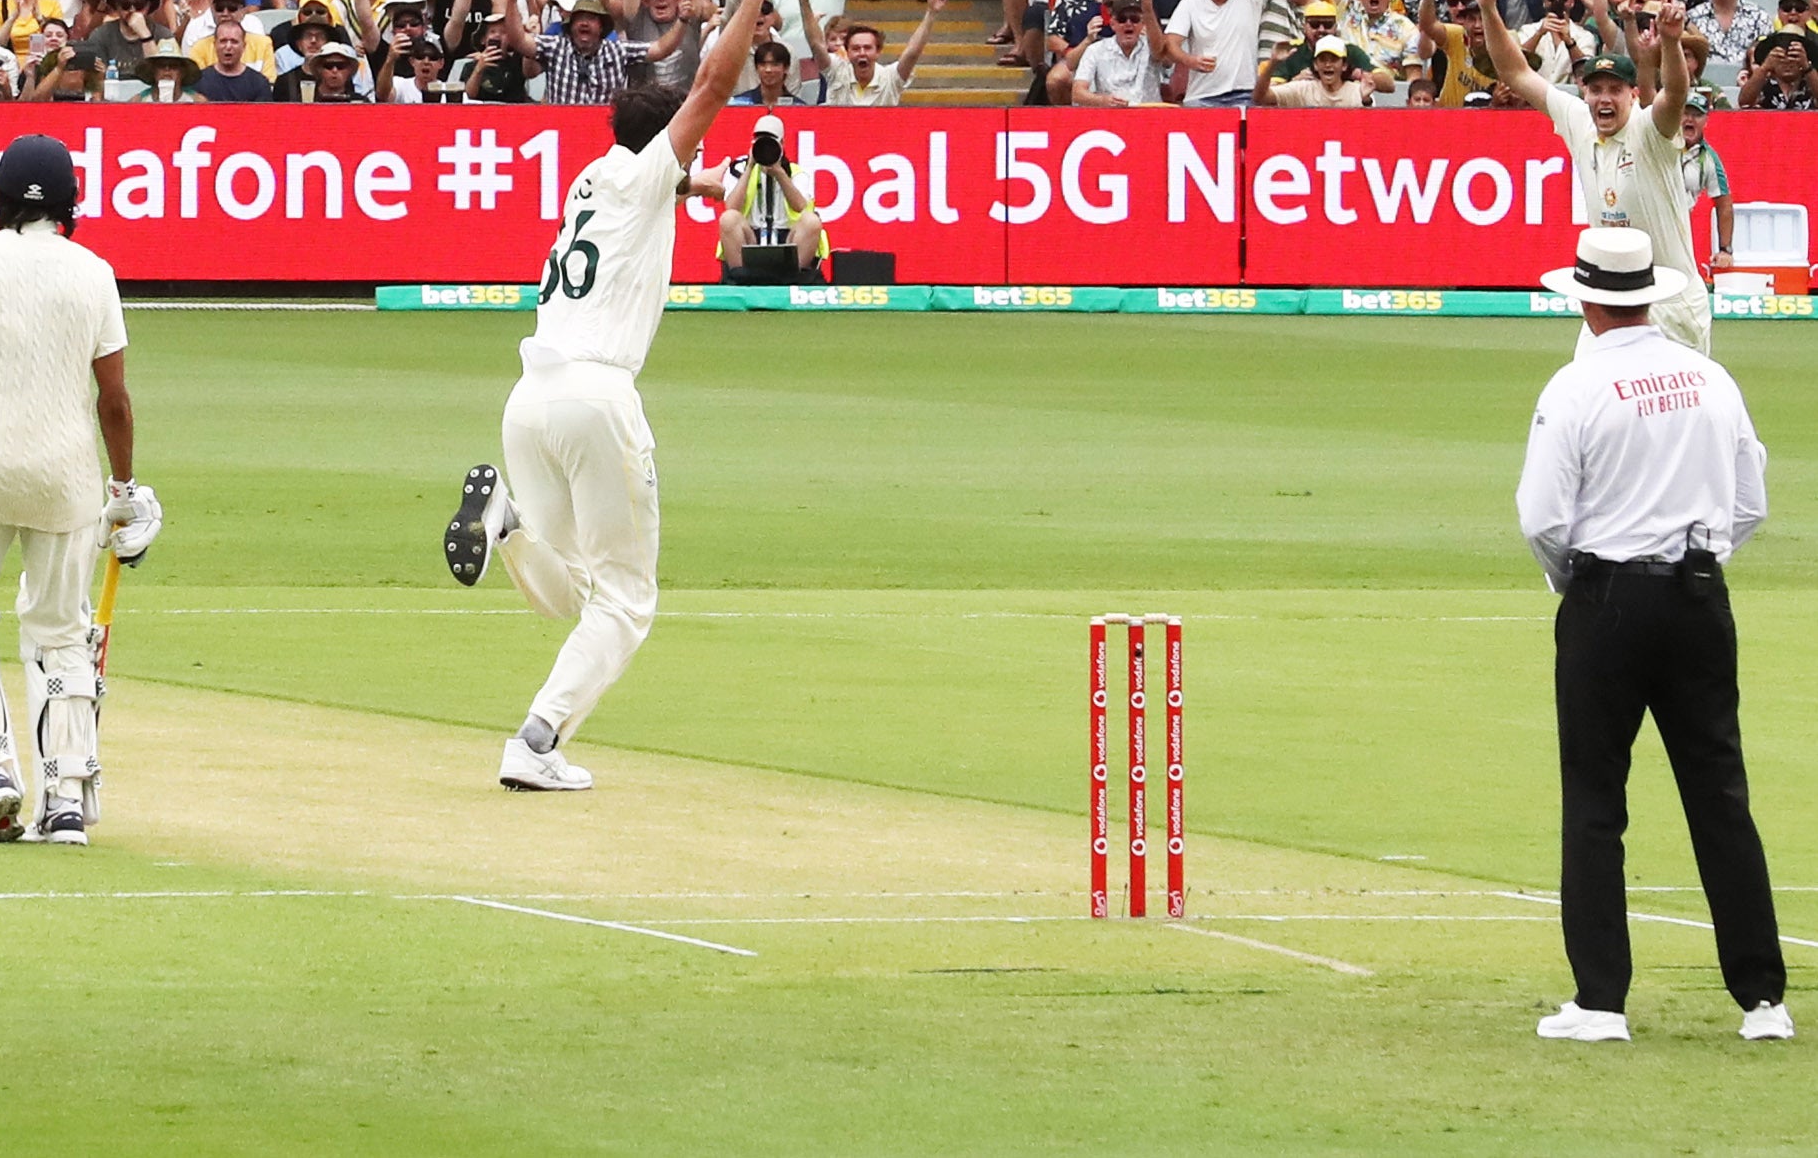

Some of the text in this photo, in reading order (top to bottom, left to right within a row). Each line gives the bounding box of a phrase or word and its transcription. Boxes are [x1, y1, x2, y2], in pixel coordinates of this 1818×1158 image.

[438, 129, 560, 220] #1
[988, 129, 1129, 225] 5G
[421, 285, 520, 305] bet365
[789, 285, 889, 305] bet365
[973, 286, 1072, 306] bet365
[1157, 287, 1257, 308] bet365
[1342, 289, 1442, 310] bet365
[1530, 292, 1580, 312] bet
[1713, 295, 1814, 315] bet365
[1612, 371, 1707, 401] Emirates
[1637, 390, 1701, 418] FLY BETTER
[1096, 641, 1105, 689] vodafone
[1170, 641, 1180, 689] vodafone
[1096, 714, 1105, 763] vodafone
[1134, 716, 1144, 764] vodafone
[1170, 714, 1180, 763] vodafone
[1096, 788, 1106, 836] vodafone
[1134, 789, 1144, 837] vodafone
[1171, 788, 1181, 836] vodafone
